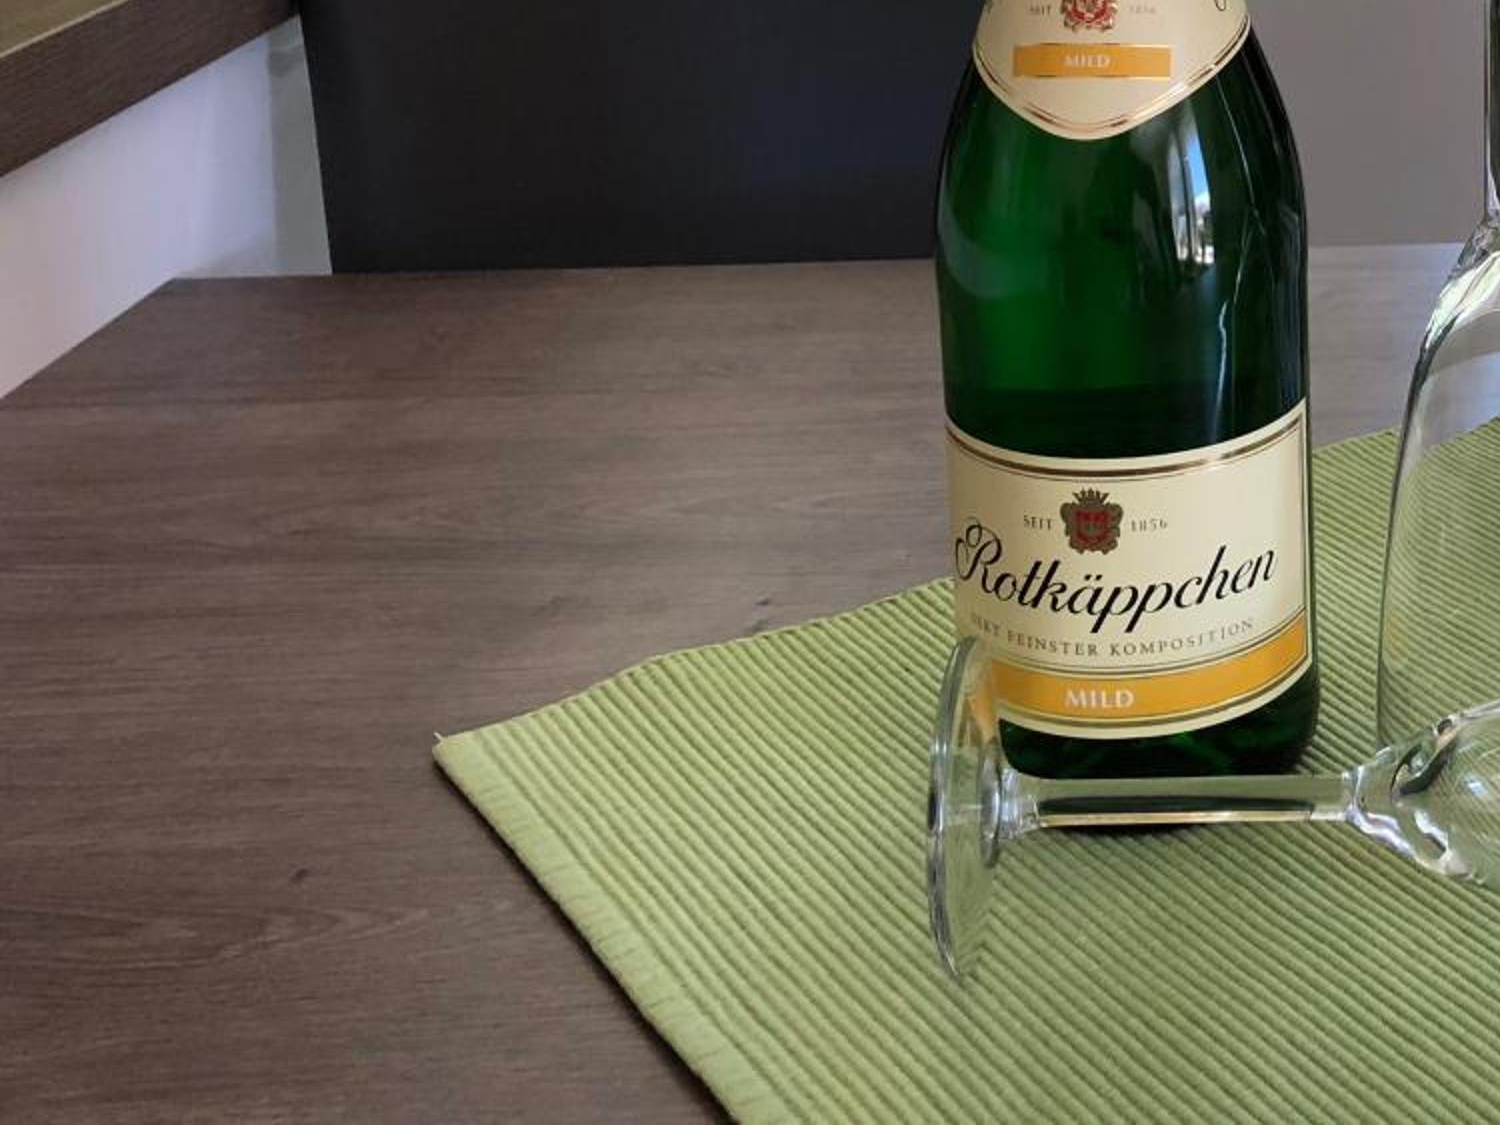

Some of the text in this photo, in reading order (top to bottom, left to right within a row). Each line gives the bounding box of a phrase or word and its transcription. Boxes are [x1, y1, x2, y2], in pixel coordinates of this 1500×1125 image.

[1022, 514, 1054, 532] SEIT
[955, 517, 1275, 634] Rotkäppchen
[1007, 629, 1098, 657] FEINSTER
[1109, 618, 1253, 657] KOMPOSITION
[1064, 687, 1135, 709] MILD
